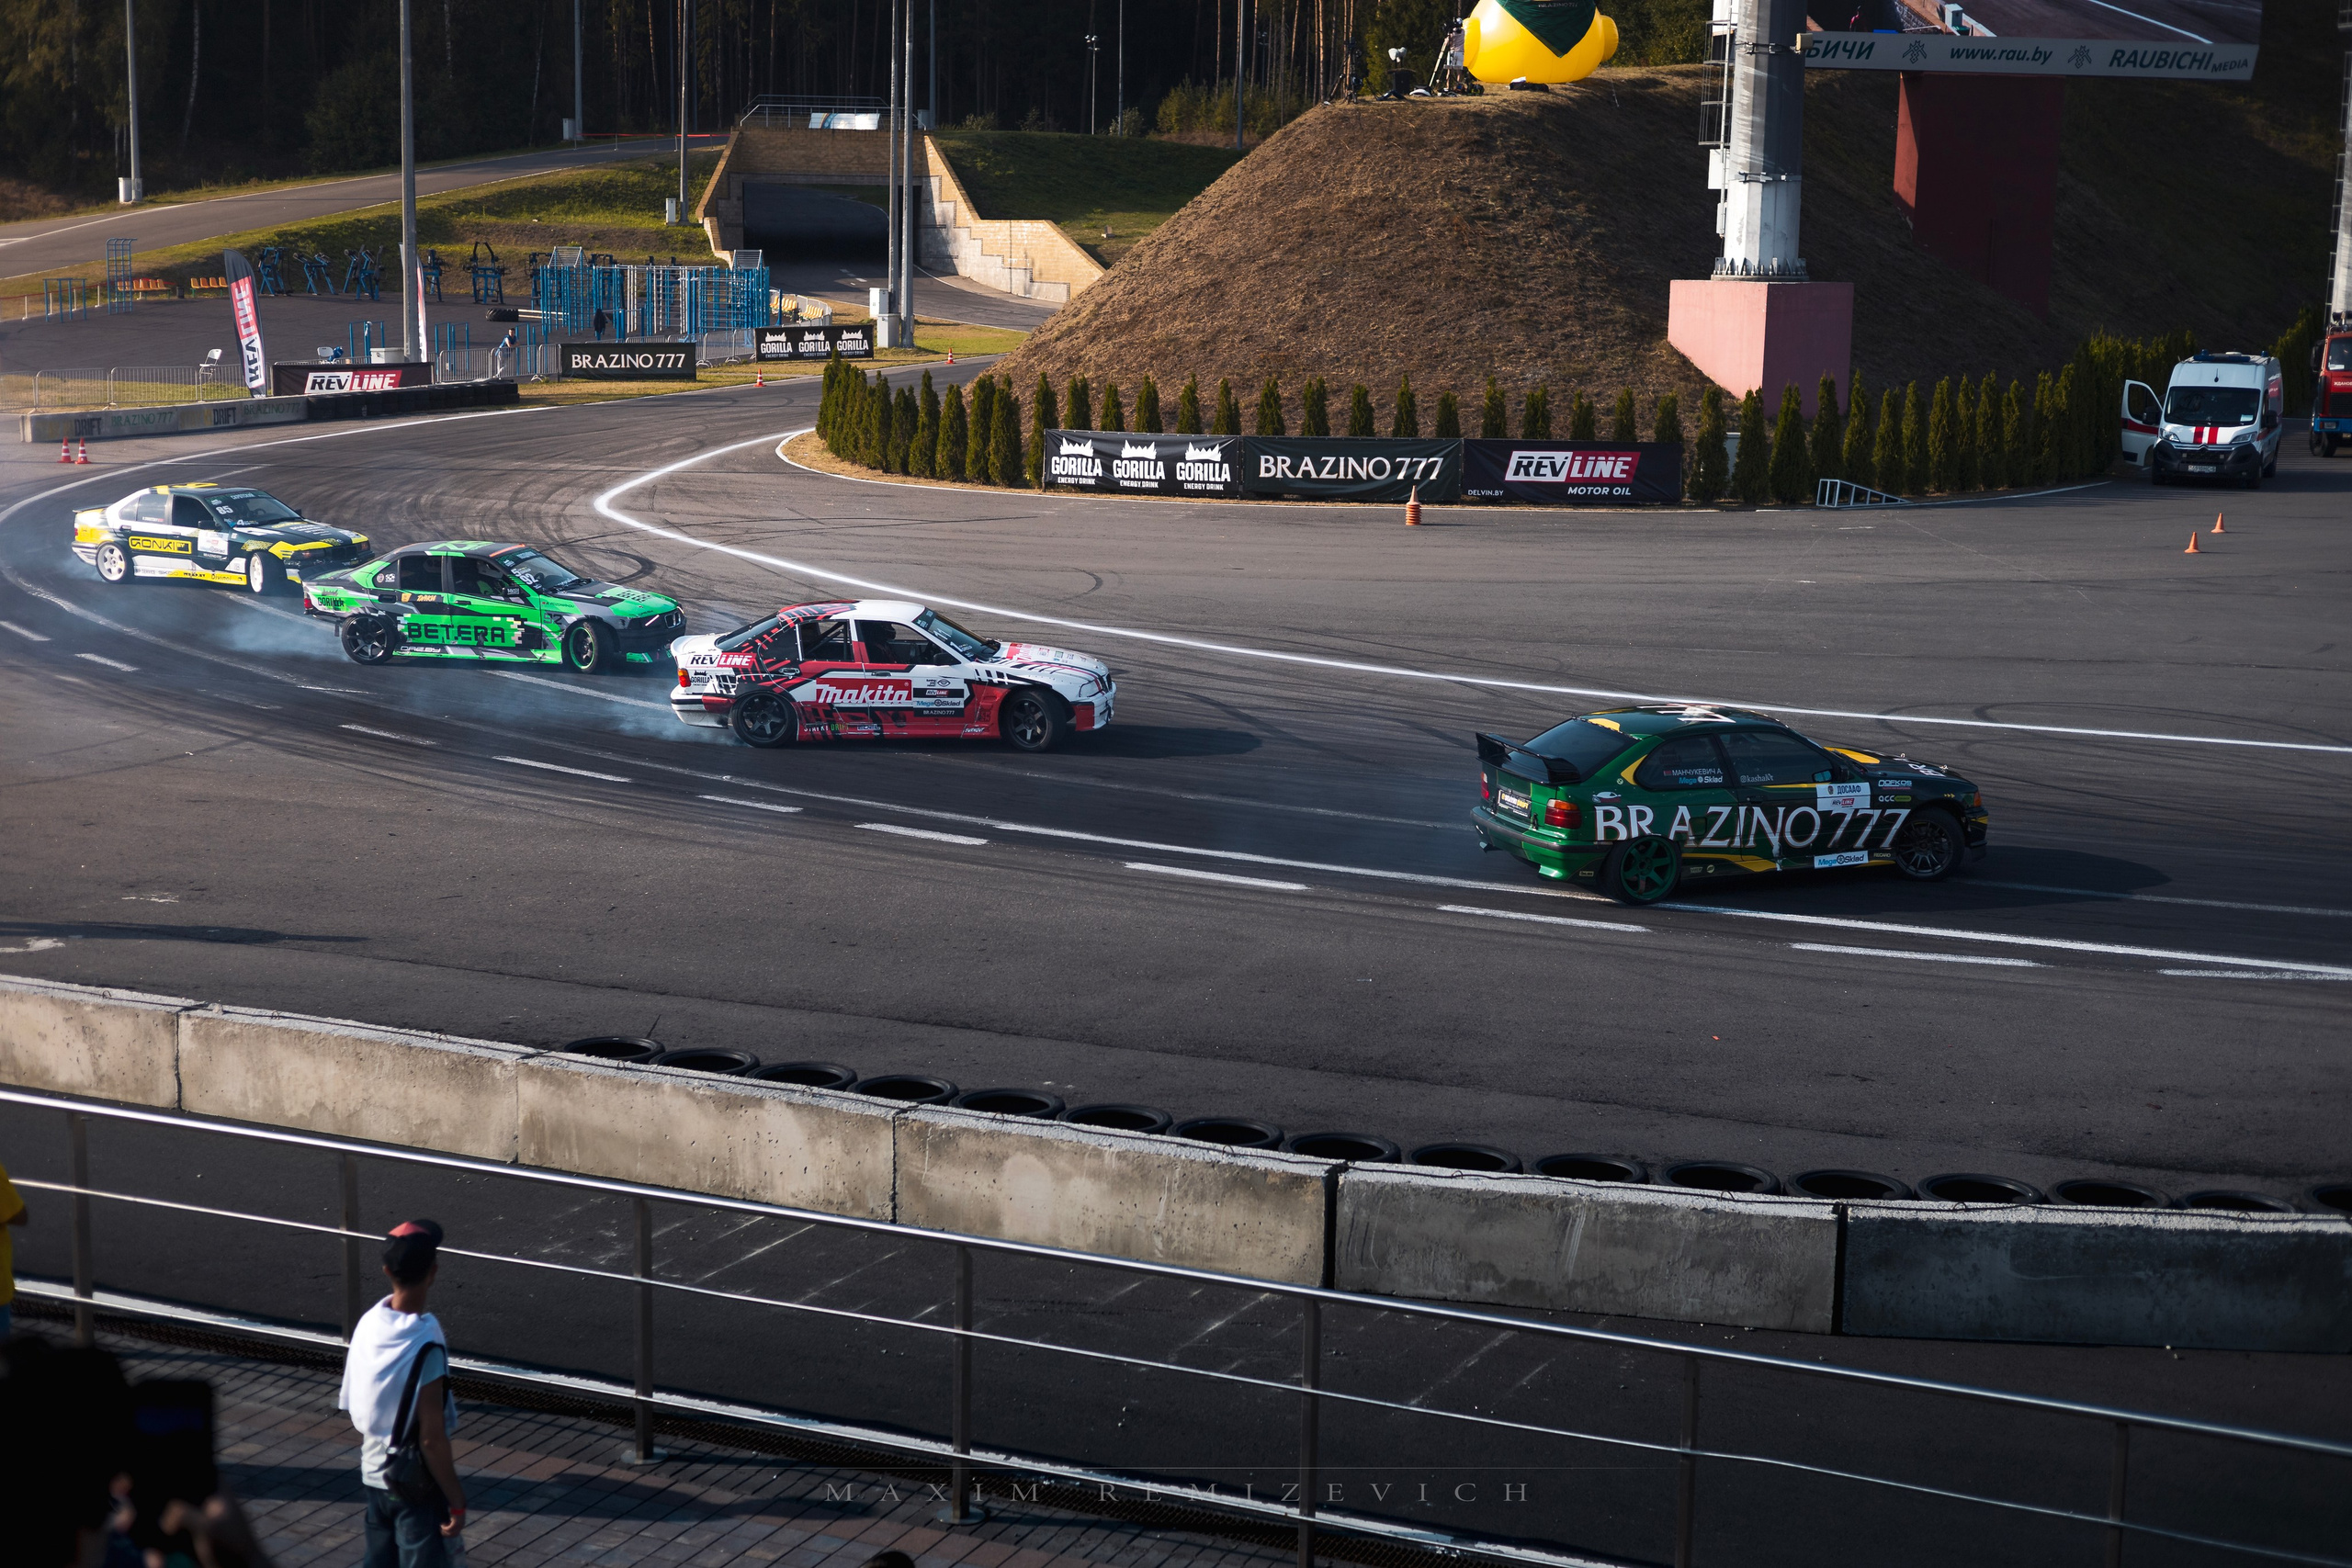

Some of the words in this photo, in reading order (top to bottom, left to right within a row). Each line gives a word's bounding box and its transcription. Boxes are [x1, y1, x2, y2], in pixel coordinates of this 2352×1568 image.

[1949, 45, 2052, 65] www.rau.by
[2109, 49, 2213, 71] RAUBICHI
[2211, 58, 2248, 74] MEDIA
[760, 342, 793, 355] GORILLA
[797, 341, 831, 353] GORILLA
[836, 338, 869, 352] GORILLA
[571, 354, 656, 369] BRAZINO
[656, 354, 685, 369] 777
[212, 407, 236, 425] DRIFT
[243, 402, 284, 415] BRAZINO
[111, 412, 155, 427] BRAZINO
[156, 411, 174, 423] 777
[74, 417, 102, 437] DRIFT
[1050, 456, 1102, 477] GORILLA
[1113, 459, 1166, 479] GORILLA
[1176, 462, 1231, 482] GORILLA
[1259, 455, 1391, 480] BRAZINO
[1394, 457, 1443, 480] 777
[1057, 476, 1078, 485] ENERGY
[1078, 477, 1096, 485] DRINK
[1119, 479, 1141, 488] ENERGY
[1141, 480, 1159, 489] DRINK
[1183, 482, 1205, 491] ENERGY
[1567, 487, 1610, 496] MOTOR
[1612, 488, 1632, 496] OIL
[216, 505, 234, 514] 85
[130, 538, 175, 551] GONKI
[1837, 784, 1861, 795] ДОСААФ
[1594, 805, 1821, 850] BRAZINO
[1826, 808, 1912, 850] 777
